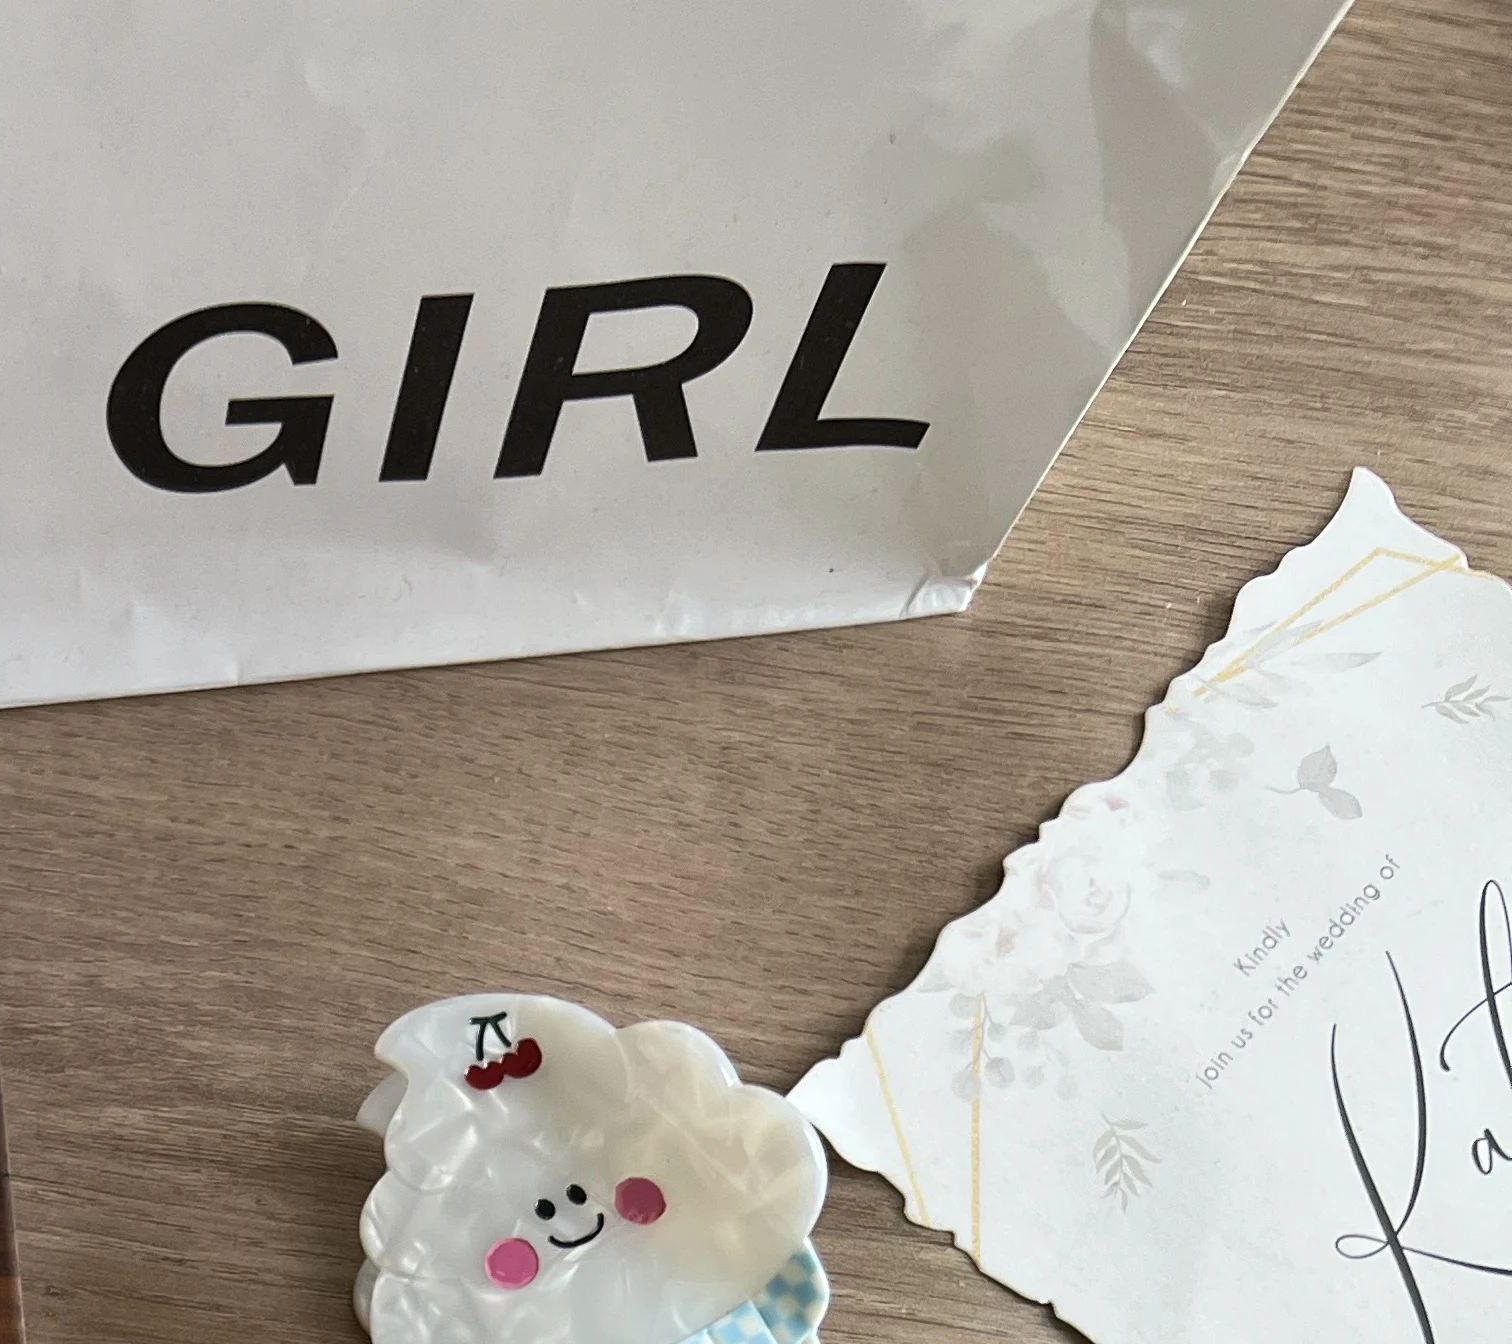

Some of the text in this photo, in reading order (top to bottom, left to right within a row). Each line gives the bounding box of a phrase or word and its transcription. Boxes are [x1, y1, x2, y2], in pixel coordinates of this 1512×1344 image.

[105, 262, 931, 493] GIRL
[1196, 854, 1400, 1089] join us for the wedding of
[1234, 918, 1290, 976] Kindly
